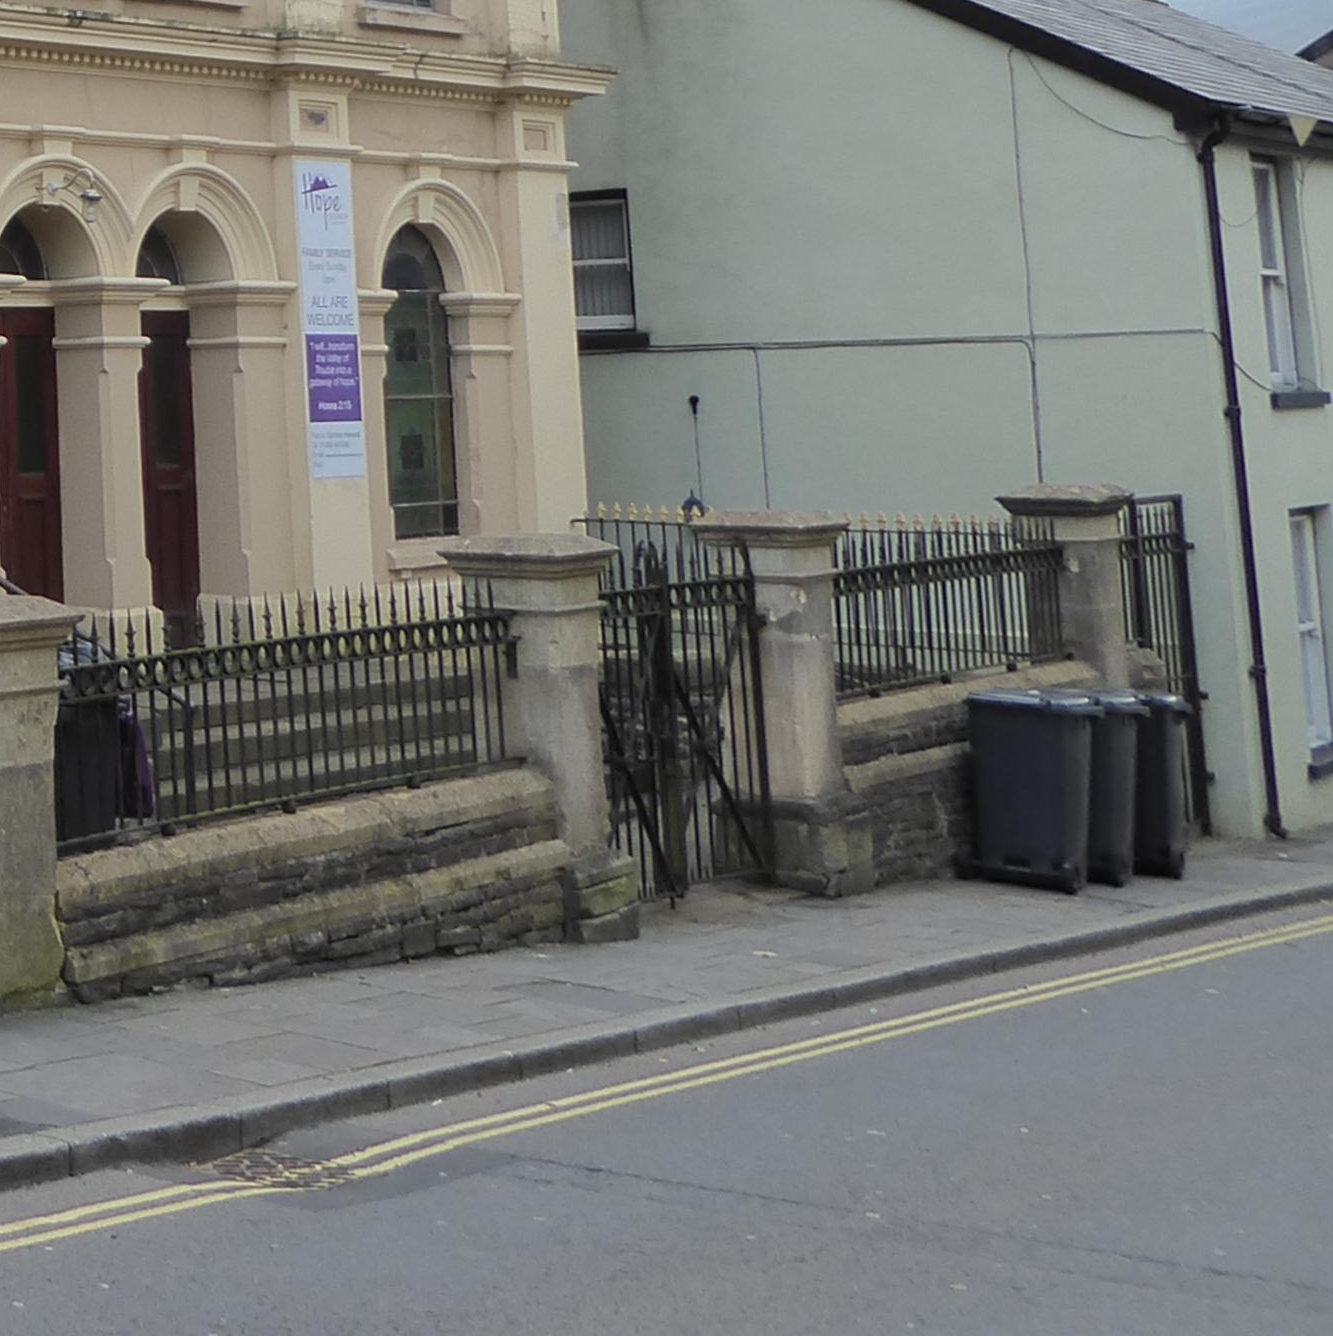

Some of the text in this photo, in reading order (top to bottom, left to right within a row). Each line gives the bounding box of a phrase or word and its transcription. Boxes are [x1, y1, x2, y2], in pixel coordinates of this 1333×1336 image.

[301, 172, 342, 231] Hope
[311, 295, 349, 309] ALL ARE
[307, 313, 354, 326] WELCOME
